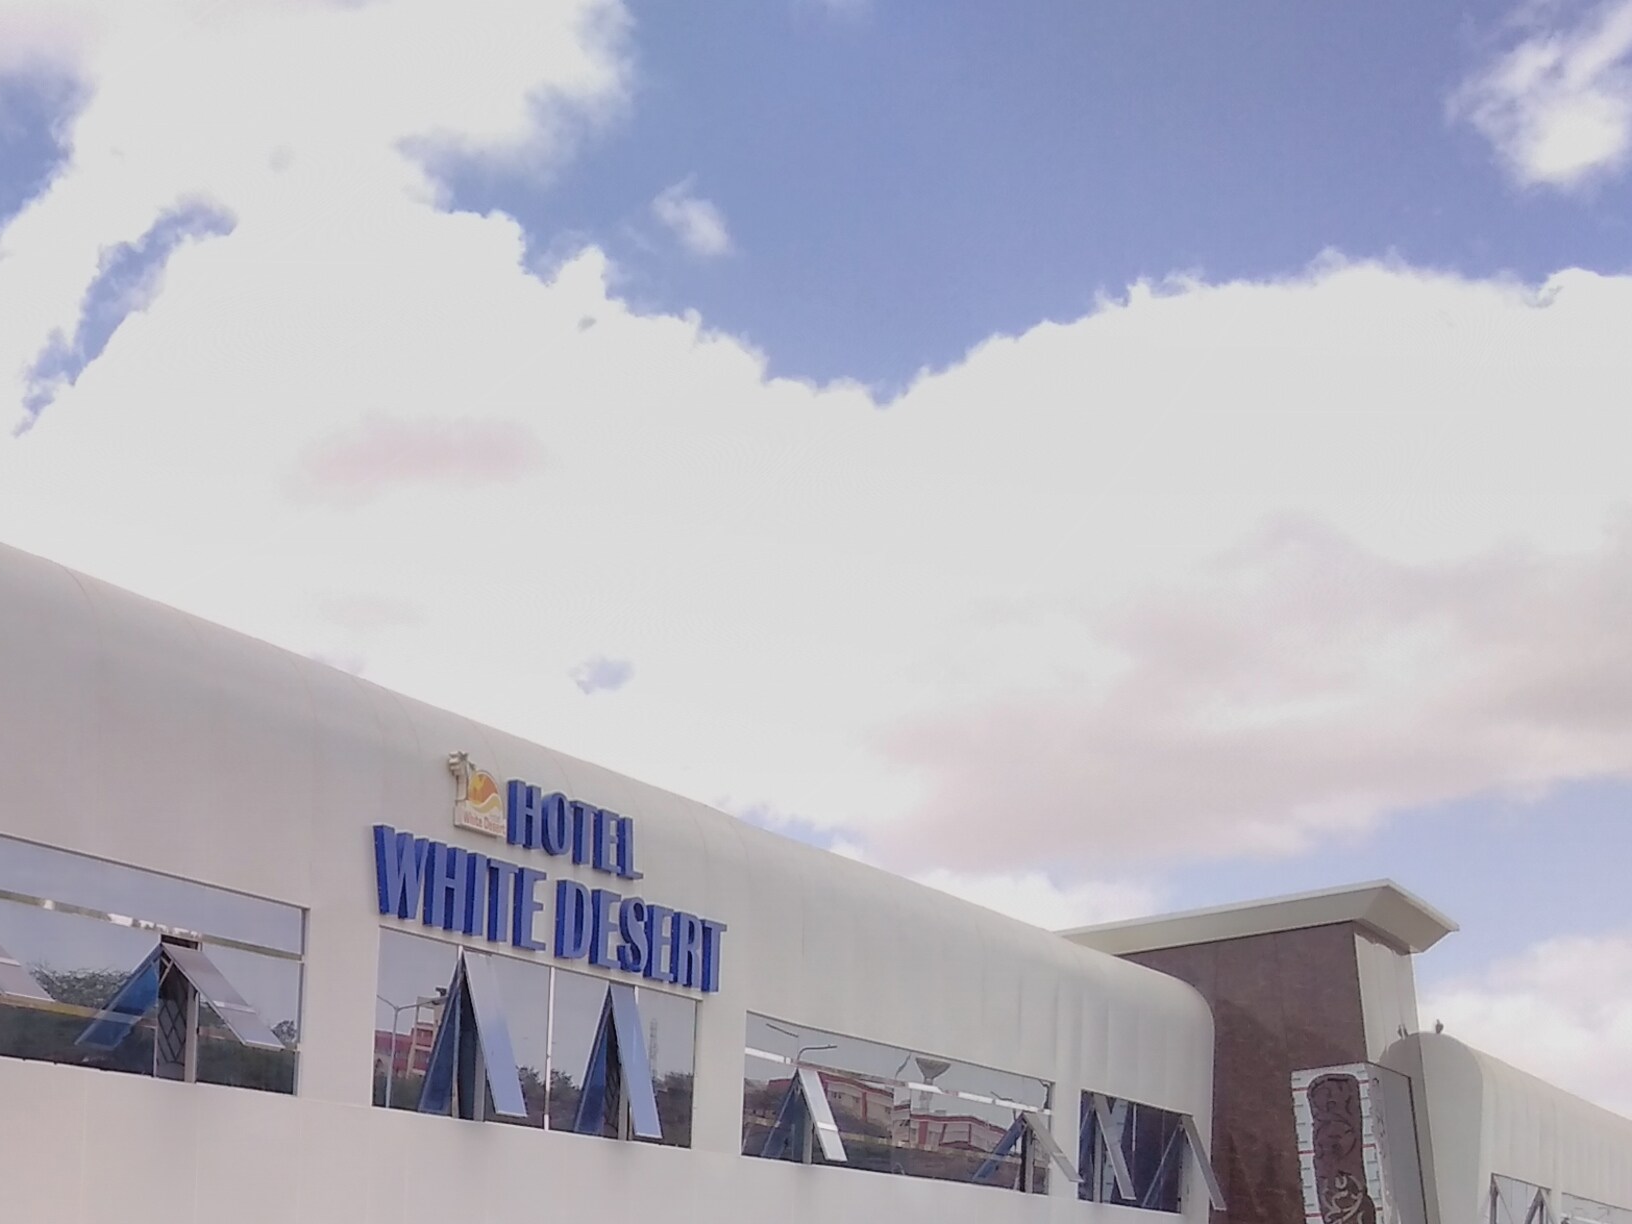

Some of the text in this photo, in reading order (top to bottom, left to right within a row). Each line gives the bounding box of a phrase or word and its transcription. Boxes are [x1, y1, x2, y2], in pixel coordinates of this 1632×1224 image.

[506, 777, 643, 880] HOTEL
[372, 823, 728, 993] WHITE DESERT
